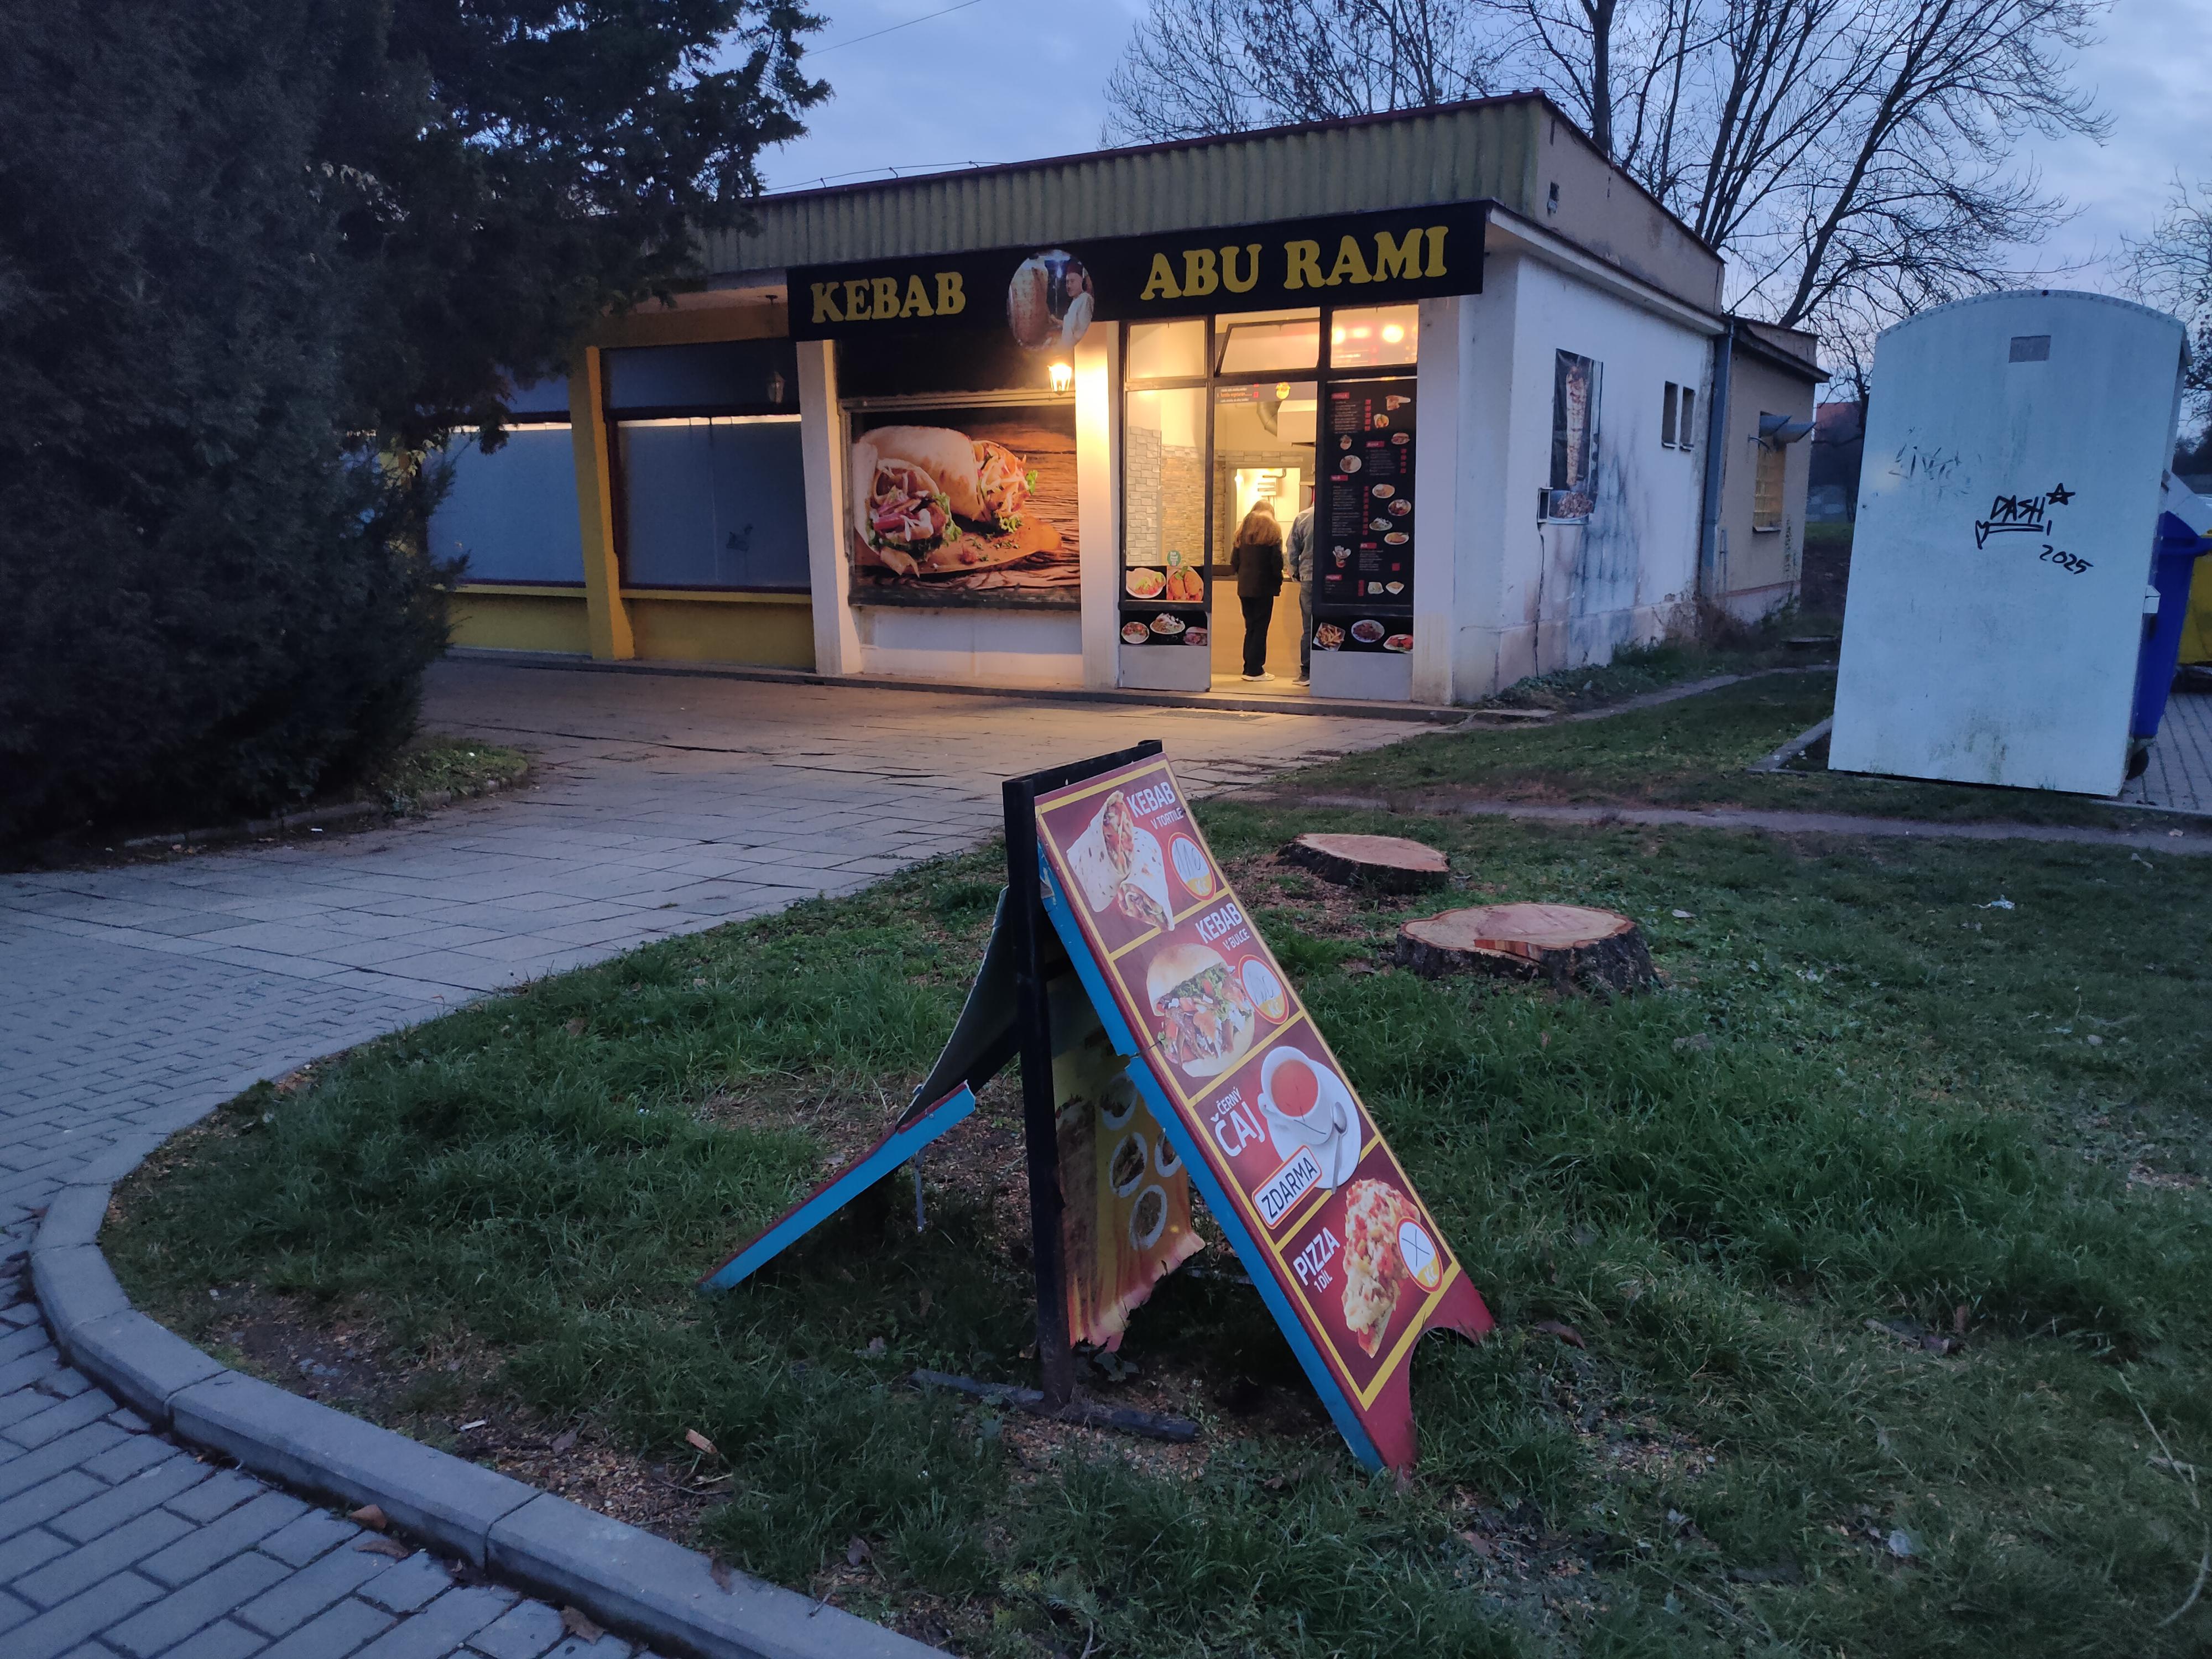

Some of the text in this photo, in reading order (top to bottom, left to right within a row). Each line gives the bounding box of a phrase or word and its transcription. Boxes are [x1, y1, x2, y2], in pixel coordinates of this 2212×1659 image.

[1140, 226, 1449, 300] ABU RAMI
[810, 272, 966, 324] KEBAB
[1990, 494, 2046, 524] DASH
[2039, 544, 2094, 575] 2025
[1126, 781, 1176, 818] KEBAB
[1150, 807, 1184, 830] V TORTILE
[1195, 902, 1243, 944] KEBAB
[1223, 928, 1250, 951] V BULCE
[1216, 1087, 1242, 1115] ČERNÝ
[1211, 1101, 1265, 1156] ČAJ
[1261, 1157, 1318, 1219] ZDARMA
[1293, 1227, 1340, 1286] PIZZA
[1314, 1269, 1333, 1293] 1 DÍL
